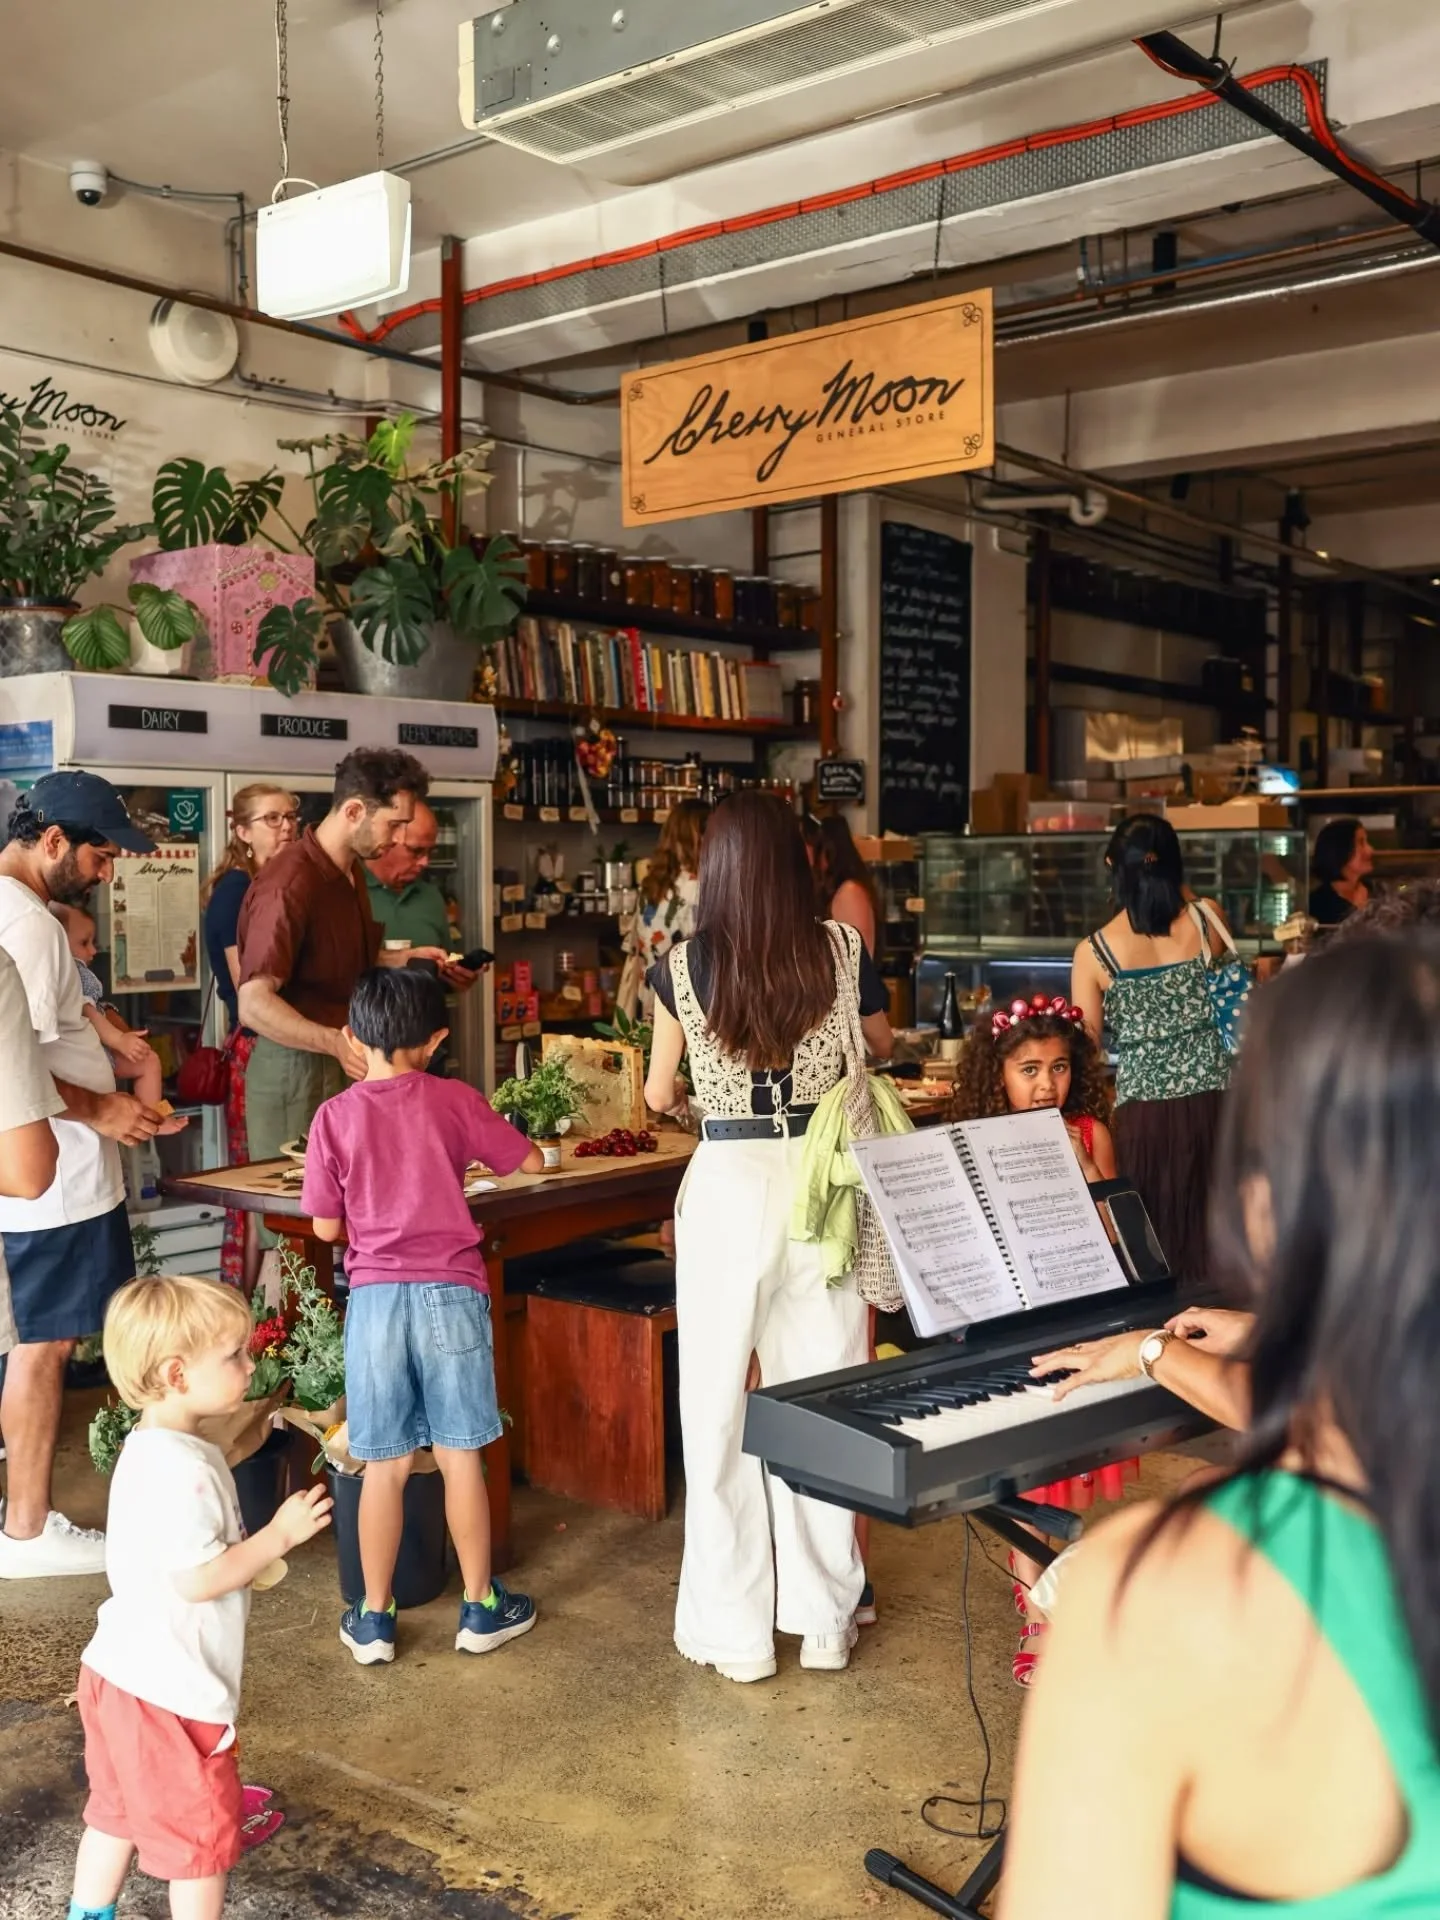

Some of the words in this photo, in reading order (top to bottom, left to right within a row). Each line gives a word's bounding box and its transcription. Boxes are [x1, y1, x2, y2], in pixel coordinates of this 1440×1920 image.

[25, 376, 127, 431] Moon
[643, 383, 819, 483] Cherry
[816, 359, 965, 428] Moon
[816, 422, 885, 444] GENERAL
[896, 410, 945, 429] STORE
[141, 708, 180, 731] DAIRY
[277, 716, 332, 737] PRODUCE
